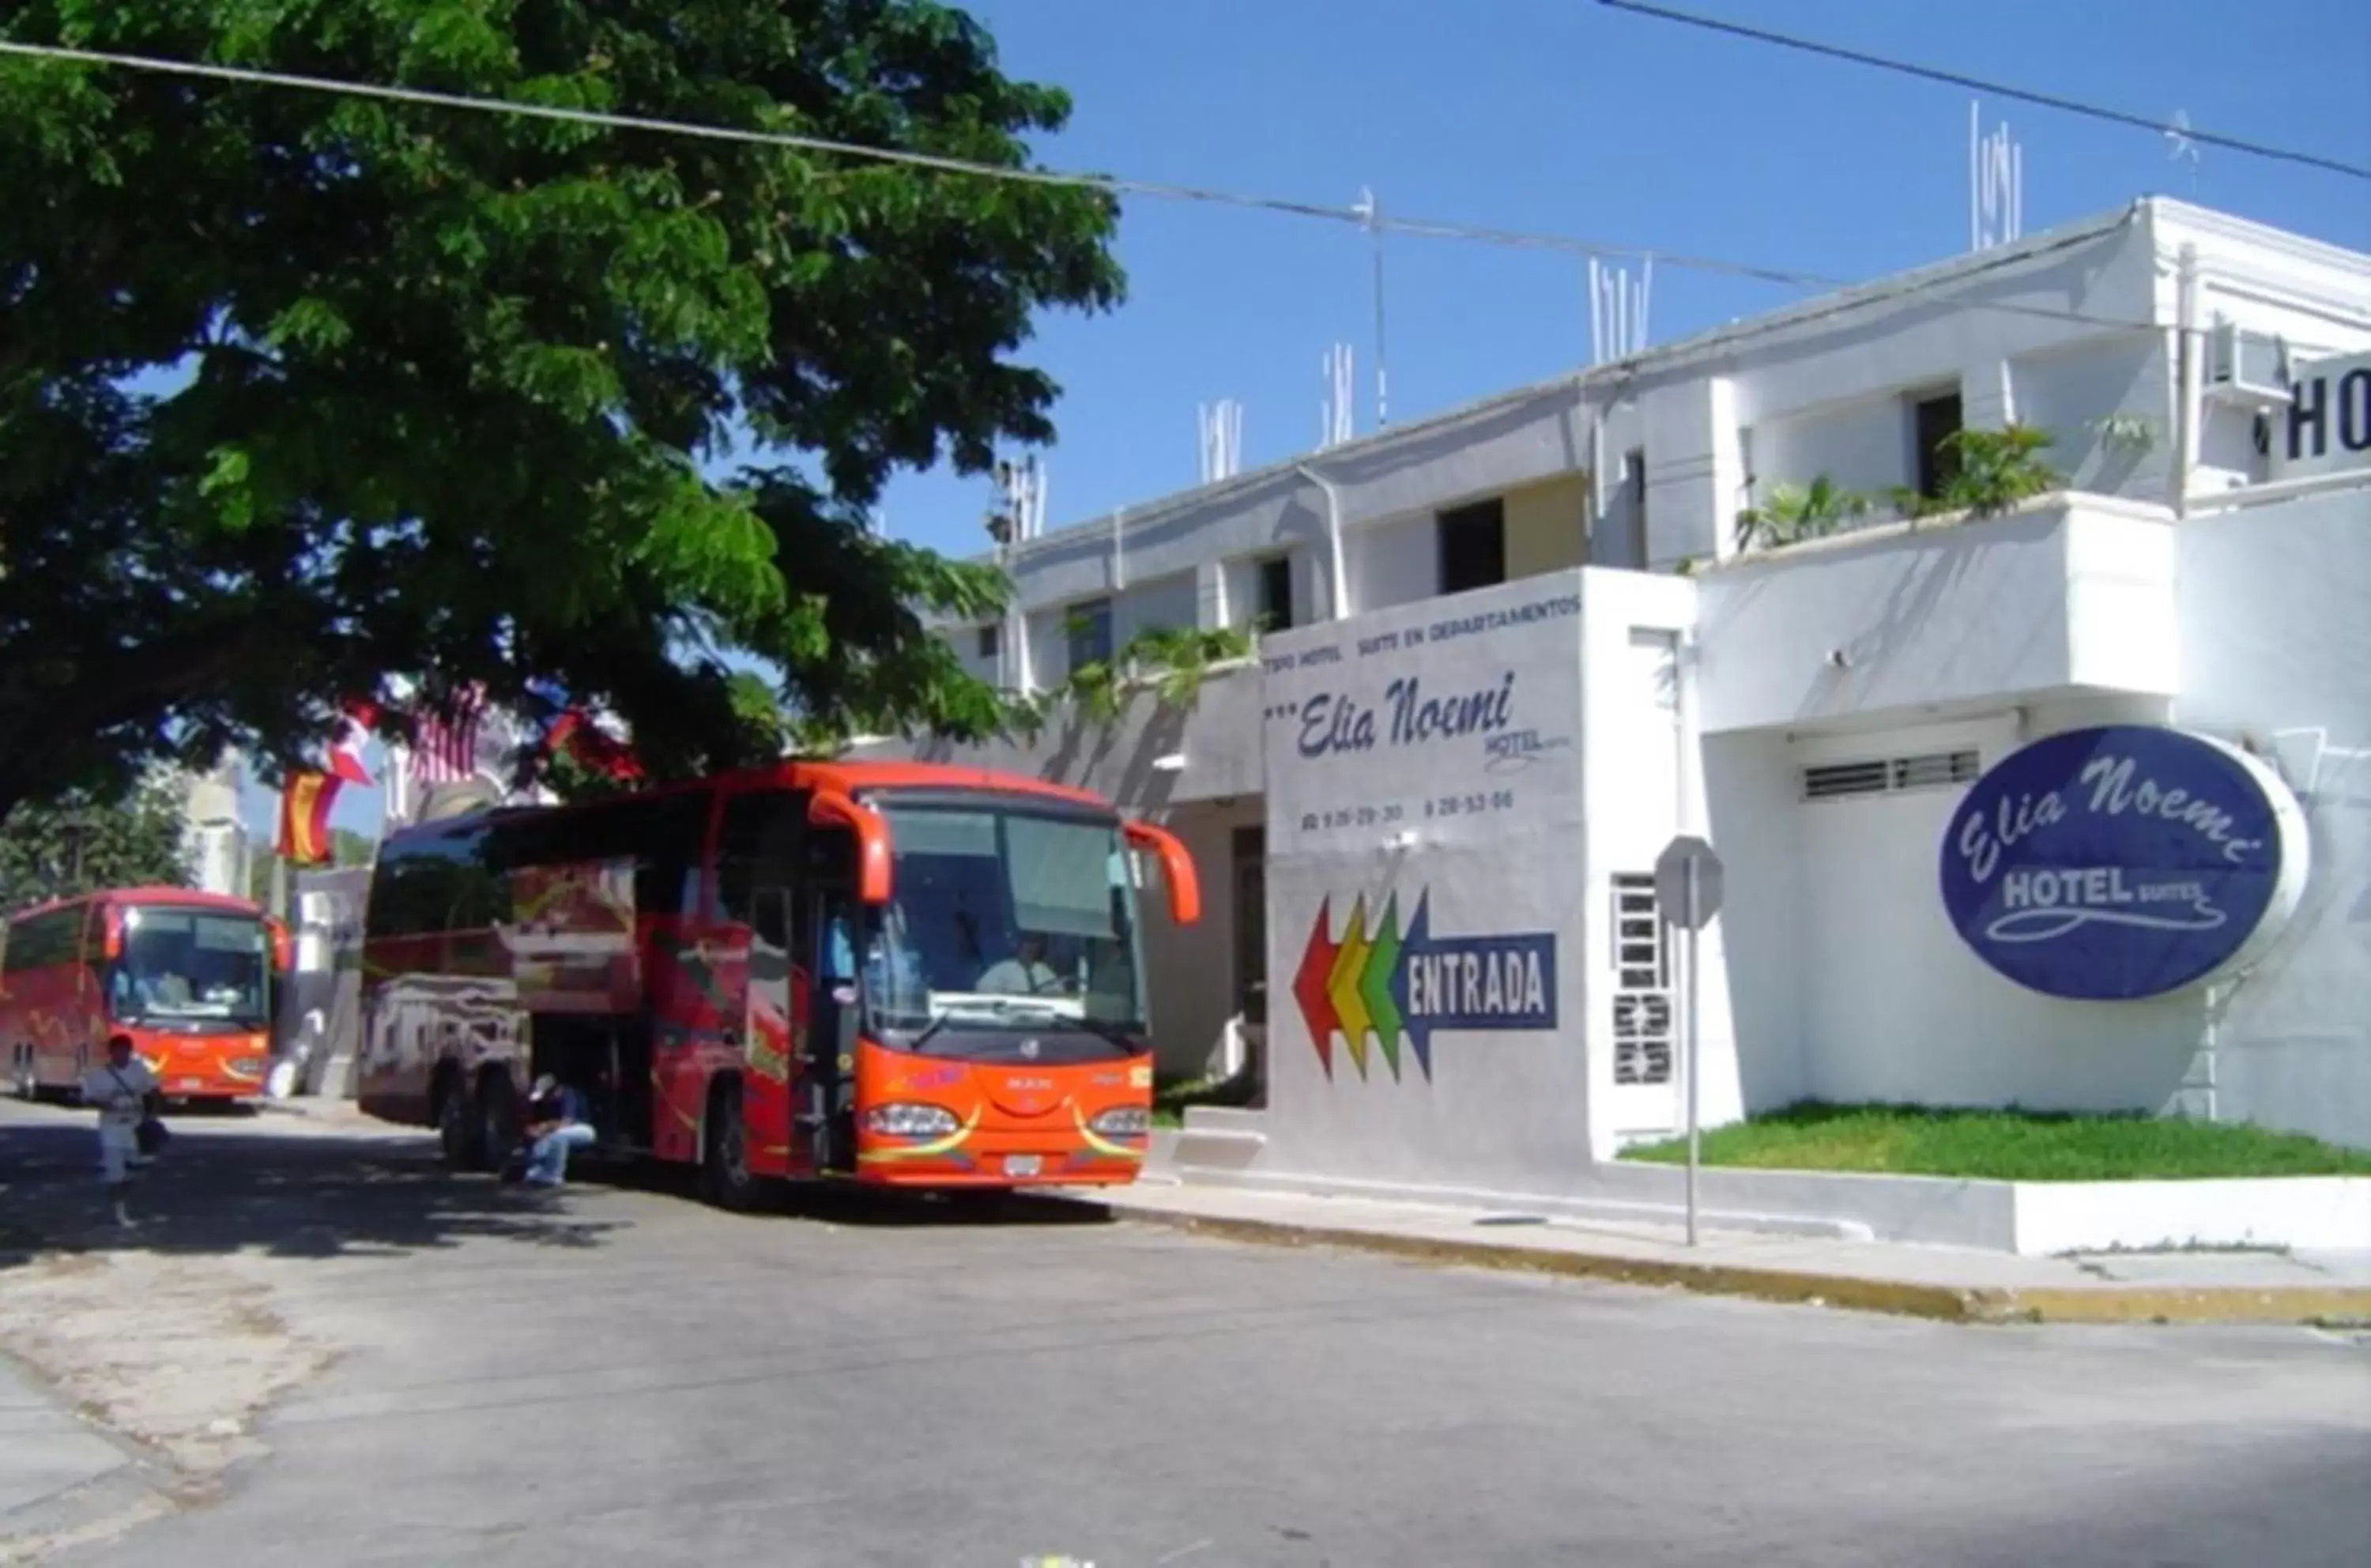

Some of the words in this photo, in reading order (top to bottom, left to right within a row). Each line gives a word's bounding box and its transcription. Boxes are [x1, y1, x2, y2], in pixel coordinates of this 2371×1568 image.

[1299, 646, 1342, 665] HOTEL
[1404, 630, 1424, 648] EN
[1429, 594, 1581, 642] DEPARTAMENTOS
[1298, 692, 1375, 757] Elia
[1385, 670, 1515, 745] Noemi
[1484, 729, 1543, 757] HOTEL
[1960, 793, 2068, 883] Elia
[2079, 756, 2262, 863] Noemi
[2003, 867, 2132, 907] HOTEL
[1408, 951, 1545, 1015] ENTRADA
